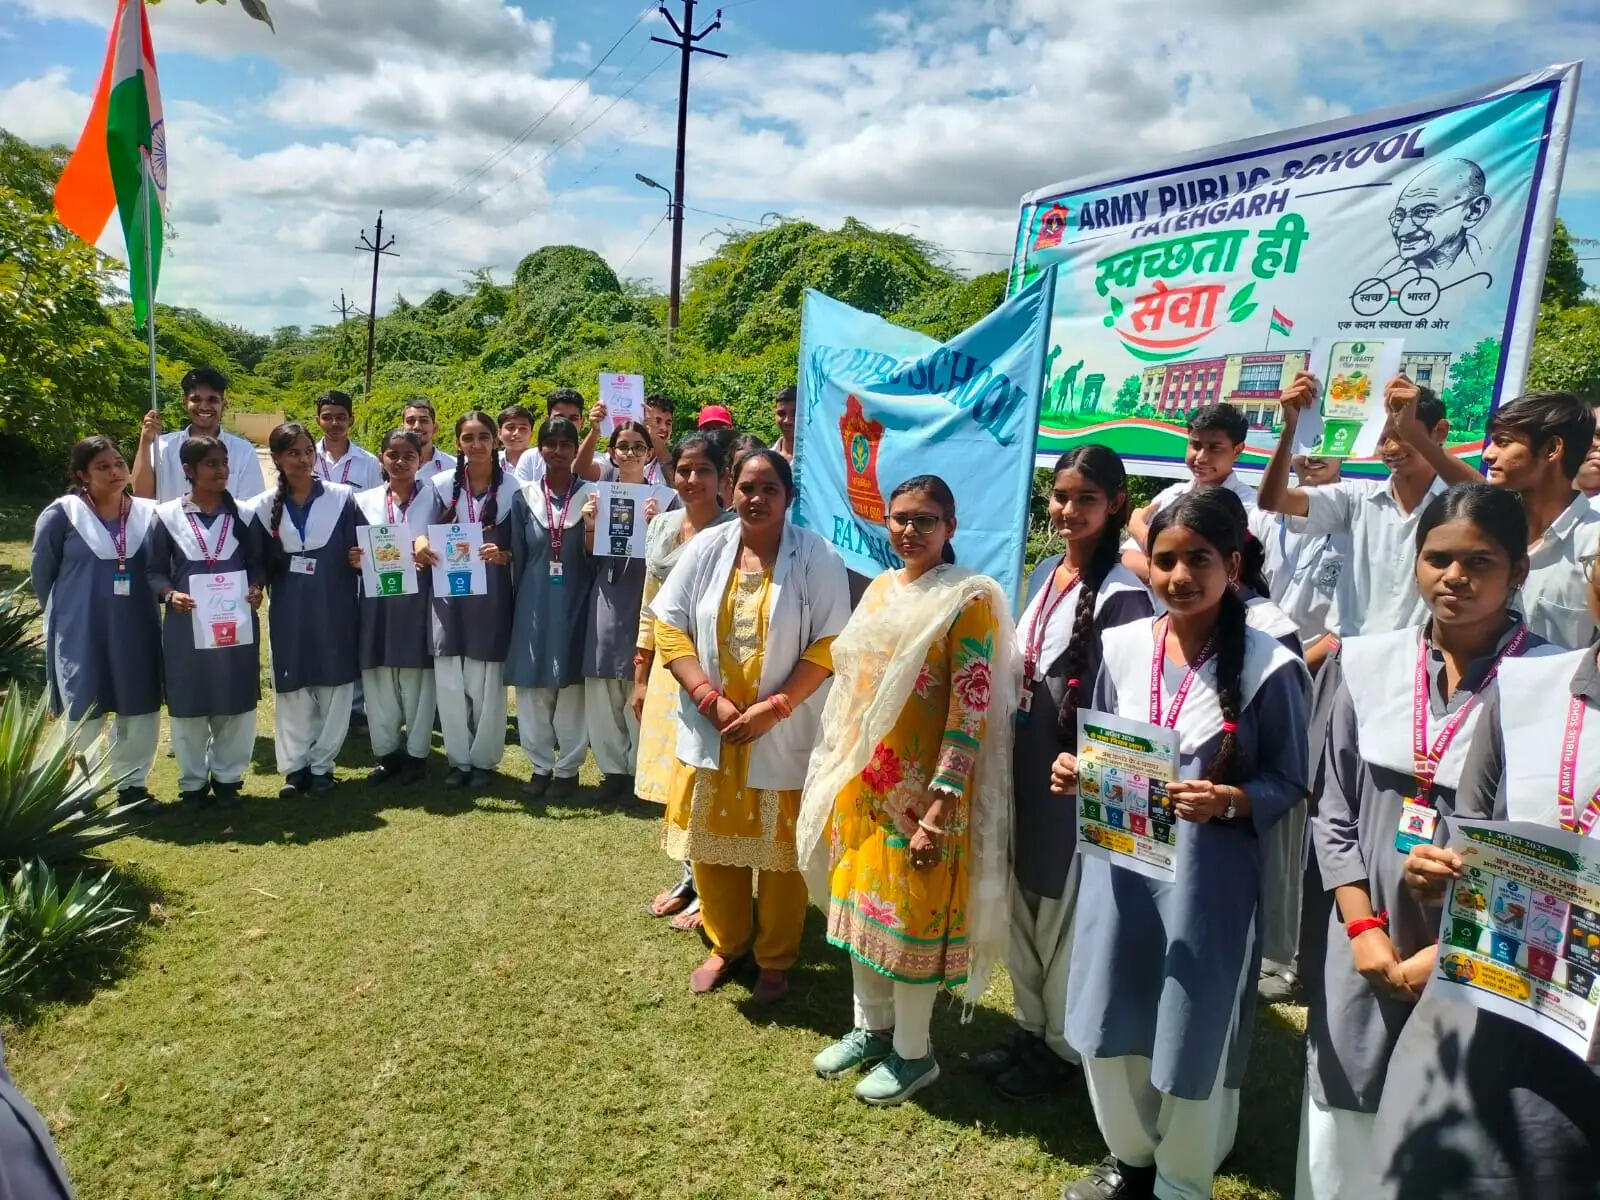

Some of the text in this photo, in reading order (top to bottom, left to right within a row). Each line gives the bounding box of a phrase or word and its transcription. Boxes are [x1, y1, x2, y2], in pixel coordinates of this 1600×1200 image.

[1078, 189, 1149, 232] ARMY
[1271, 127, 1426, 186] SCHOOL
[1095, 213, 1310, 298] स्वच्छता ही
[1130, 279, 1227, 334] सेवा
[1360, 292, 1432, 303] स्वच्छ भारत
[1338, 318, 1450, 331] एक कदम स्वच्छता की ओर
[1169, 693, 1184, 720] PUBLIC
[1415, 698, 1423, 727] PUBLIC
[1415, 728, 1423, 751] ARMY
[1434, 728, 1450, 753] ARMY
[1564, 729, 1576, 763] PUBLIC
[1561, 765, 1571, 794] ARMY
[1526, 840, 1548, 854] 2026
